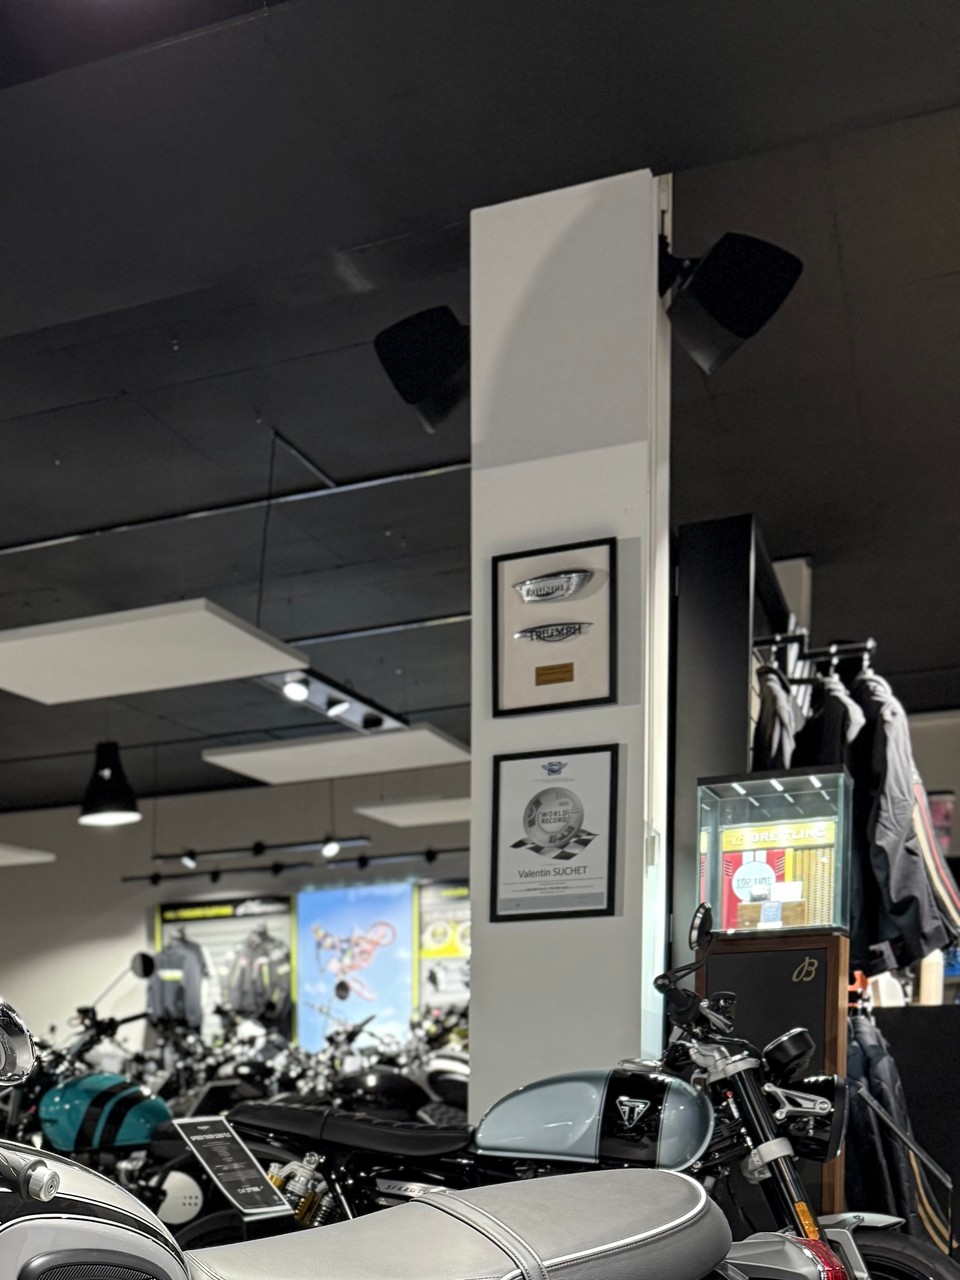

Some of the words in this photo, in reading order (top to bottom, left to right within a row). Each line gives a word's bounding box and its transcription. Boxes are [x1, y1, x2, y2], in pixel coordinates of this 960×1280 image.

[528, 625, 582, 641] TRIUMPH
[541, 810, 568, 818] WORLD
[518, 867, 551, 879] Valentin
[553, 866, 588, 877] SUCHET
